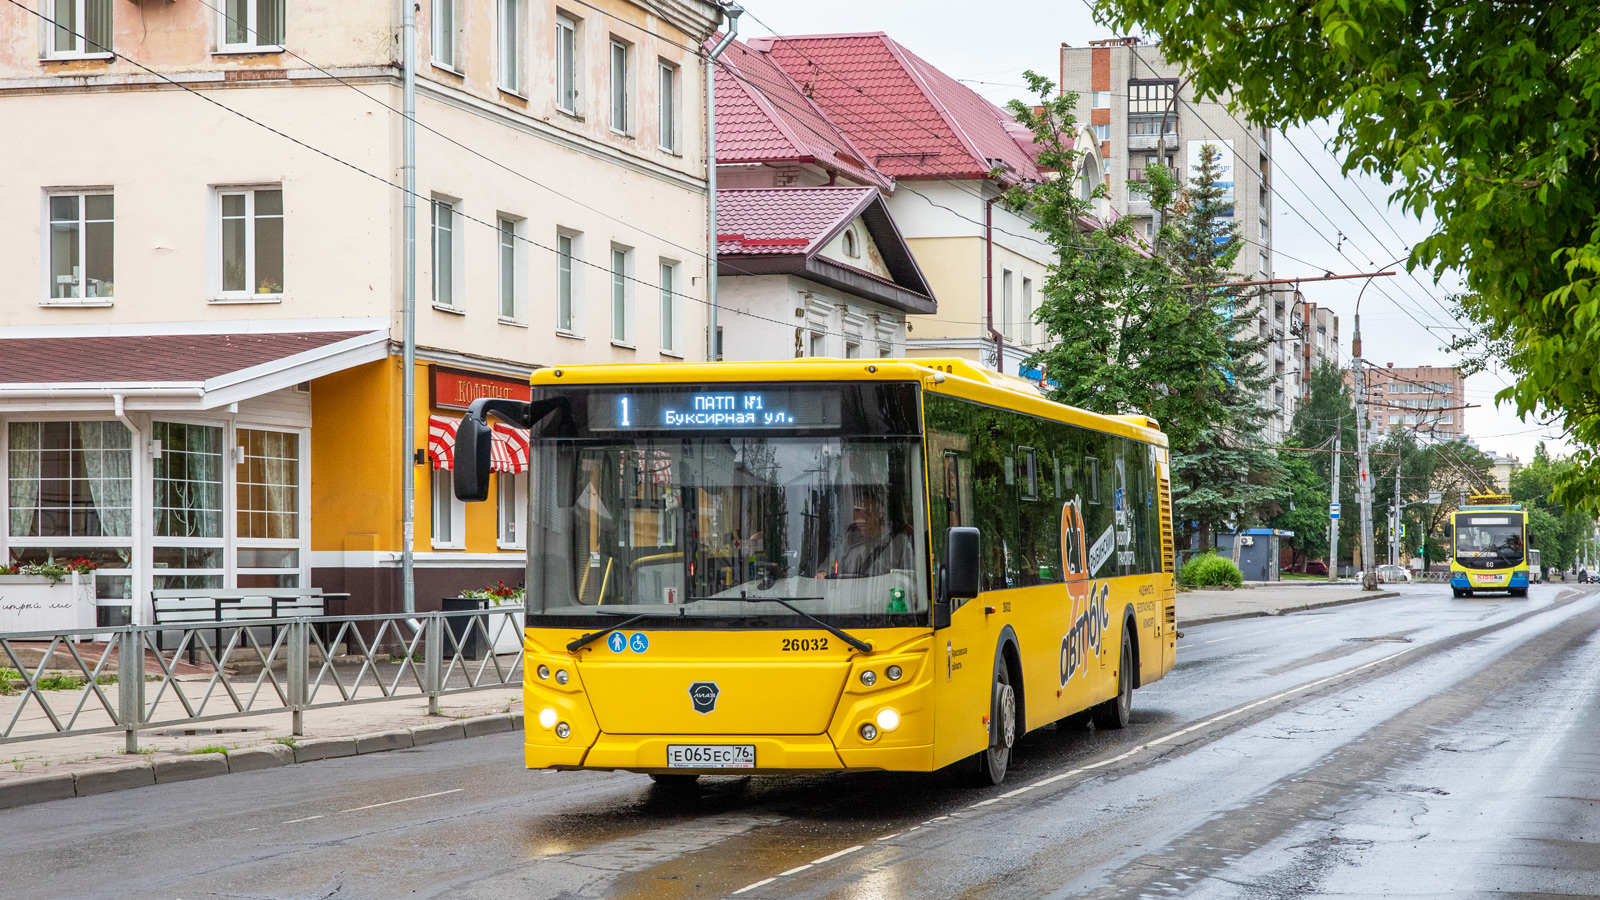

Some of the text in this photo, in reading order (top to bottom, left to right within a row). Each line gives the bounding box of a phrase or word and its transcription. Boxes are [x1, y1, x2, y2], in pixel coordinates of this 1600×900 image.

[694, 396, 735, 410] ПАТП
[621, 397, 630, 426] 1
[665, 410, 794, 426] Буксирная ул.
[0, 596, 41, 616] итрый
[782, 638, 829, 651] 26032
